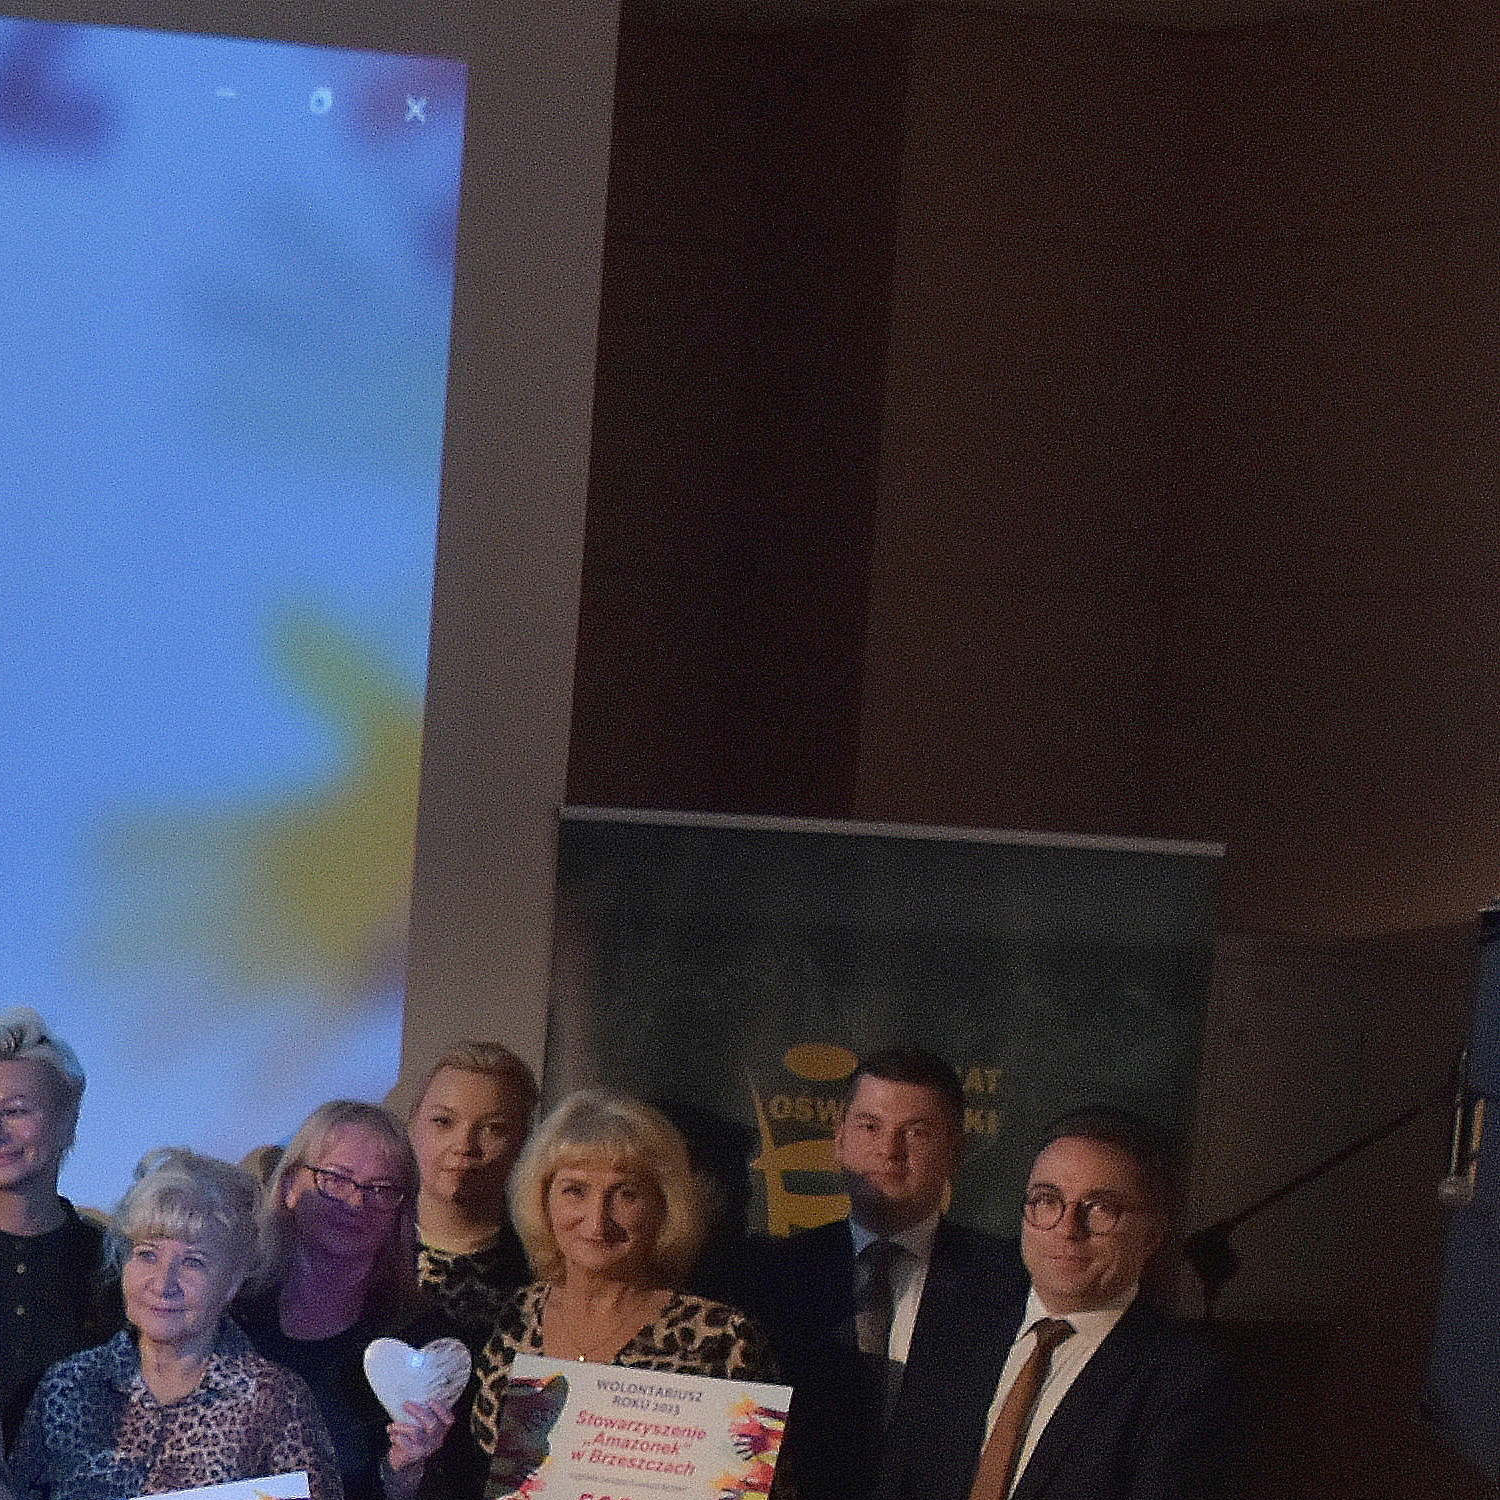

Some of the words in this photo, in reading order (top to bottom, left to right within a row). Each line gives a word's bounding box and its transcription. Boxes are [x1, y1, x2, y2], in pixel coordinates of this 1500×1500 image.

[597, 1379, 704, 1402] WOLONTARIUSZ
[611, 1397, 650, 1412] ROKU
[575, 1410, 707, 1441] Stowarzyszenie
[570, 1451, 586, 1462] w
[588, 1450, 697, 1477] Brzeszczach
